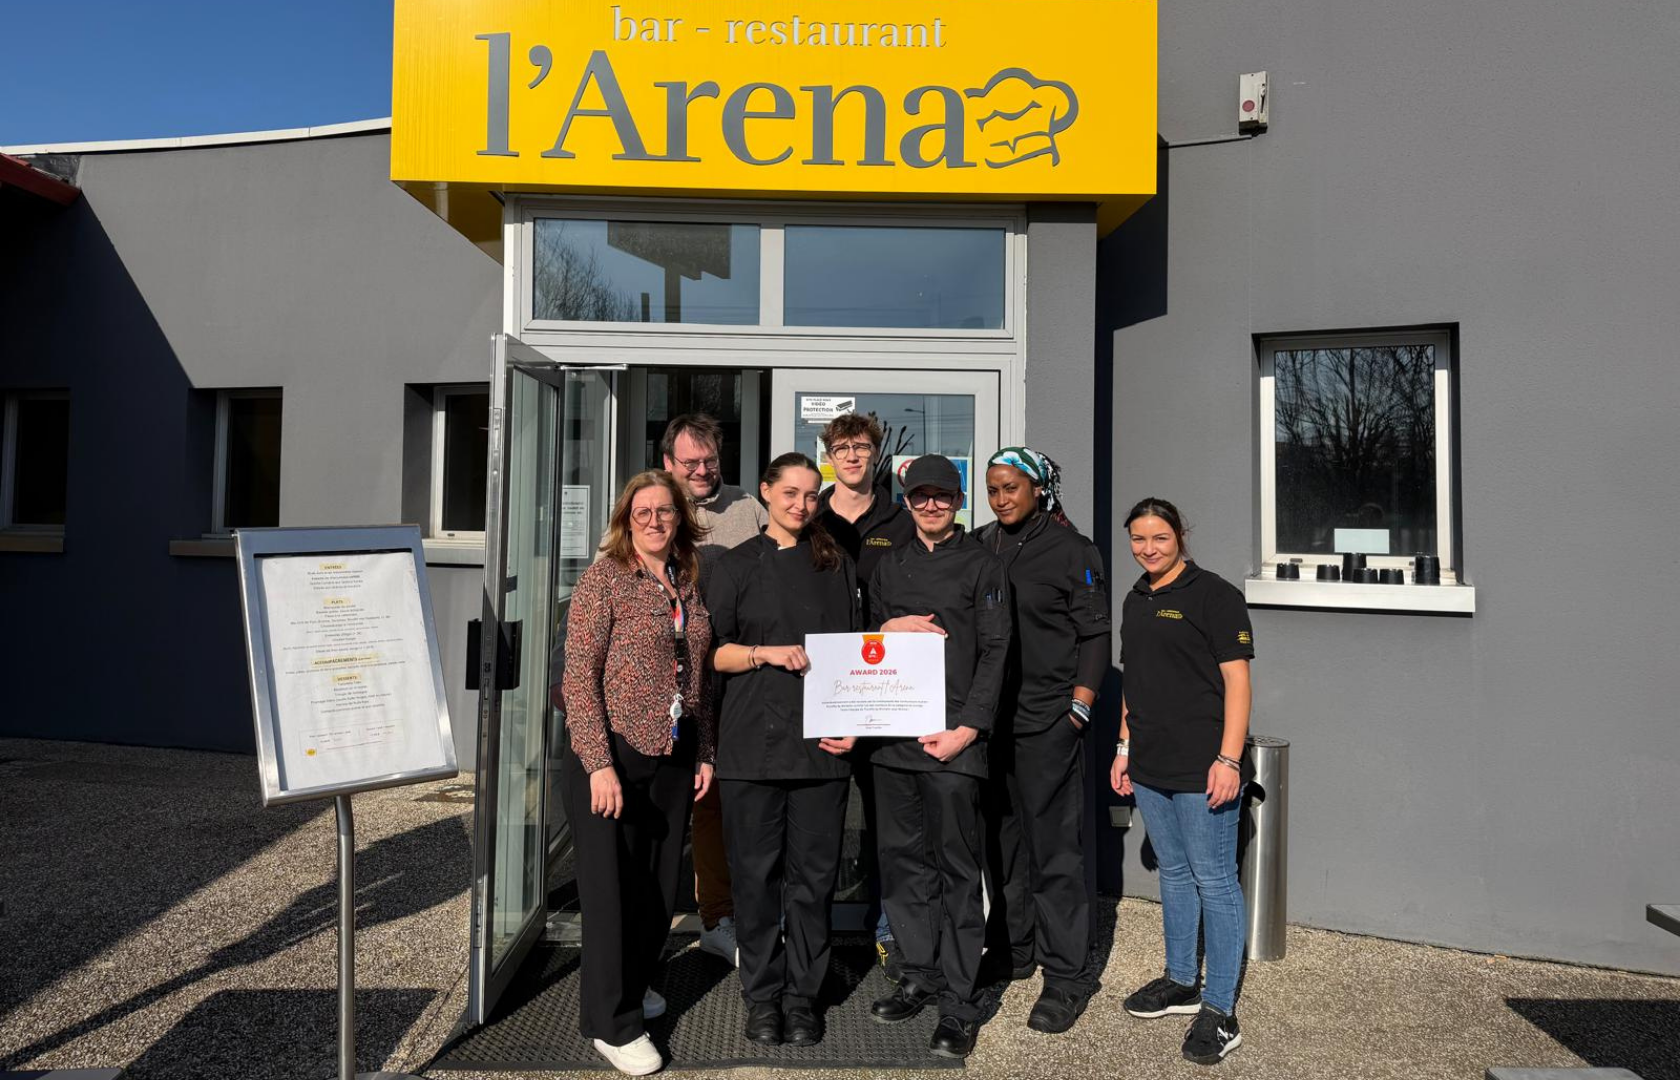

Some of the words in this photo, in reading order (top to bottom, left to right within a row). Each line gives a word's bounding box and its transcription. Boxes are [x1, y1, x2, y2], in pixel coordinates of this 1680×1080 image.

[610, 5, 683, 42] bar
[724, 15, 947, 47] restaurant
[833, 679, 851, 697] Bar
